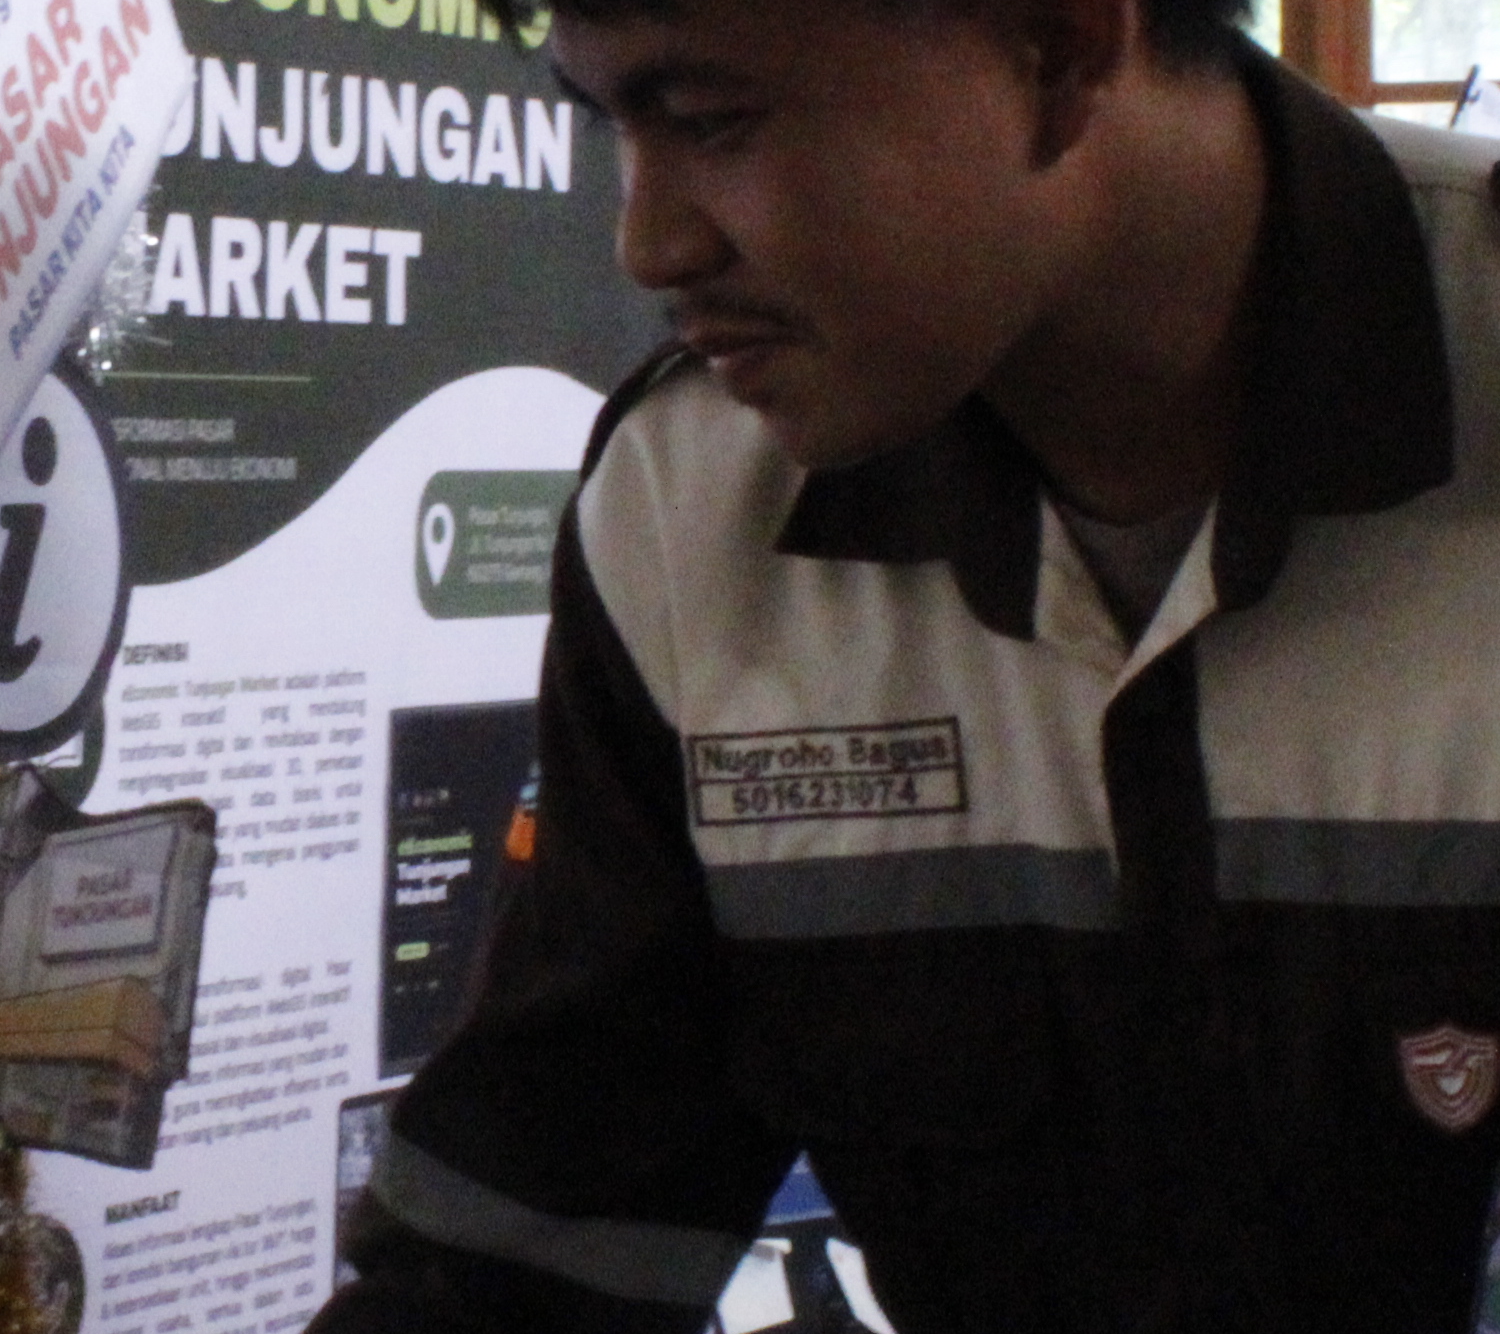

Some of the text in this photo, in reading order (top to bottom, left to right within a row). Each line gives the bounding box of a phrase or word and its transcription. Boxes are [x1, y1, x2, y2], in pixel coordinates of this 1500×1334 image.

[8, 248, 67, 362] PASAR
[701, 729, 949, 780] Nugroho Bagus
